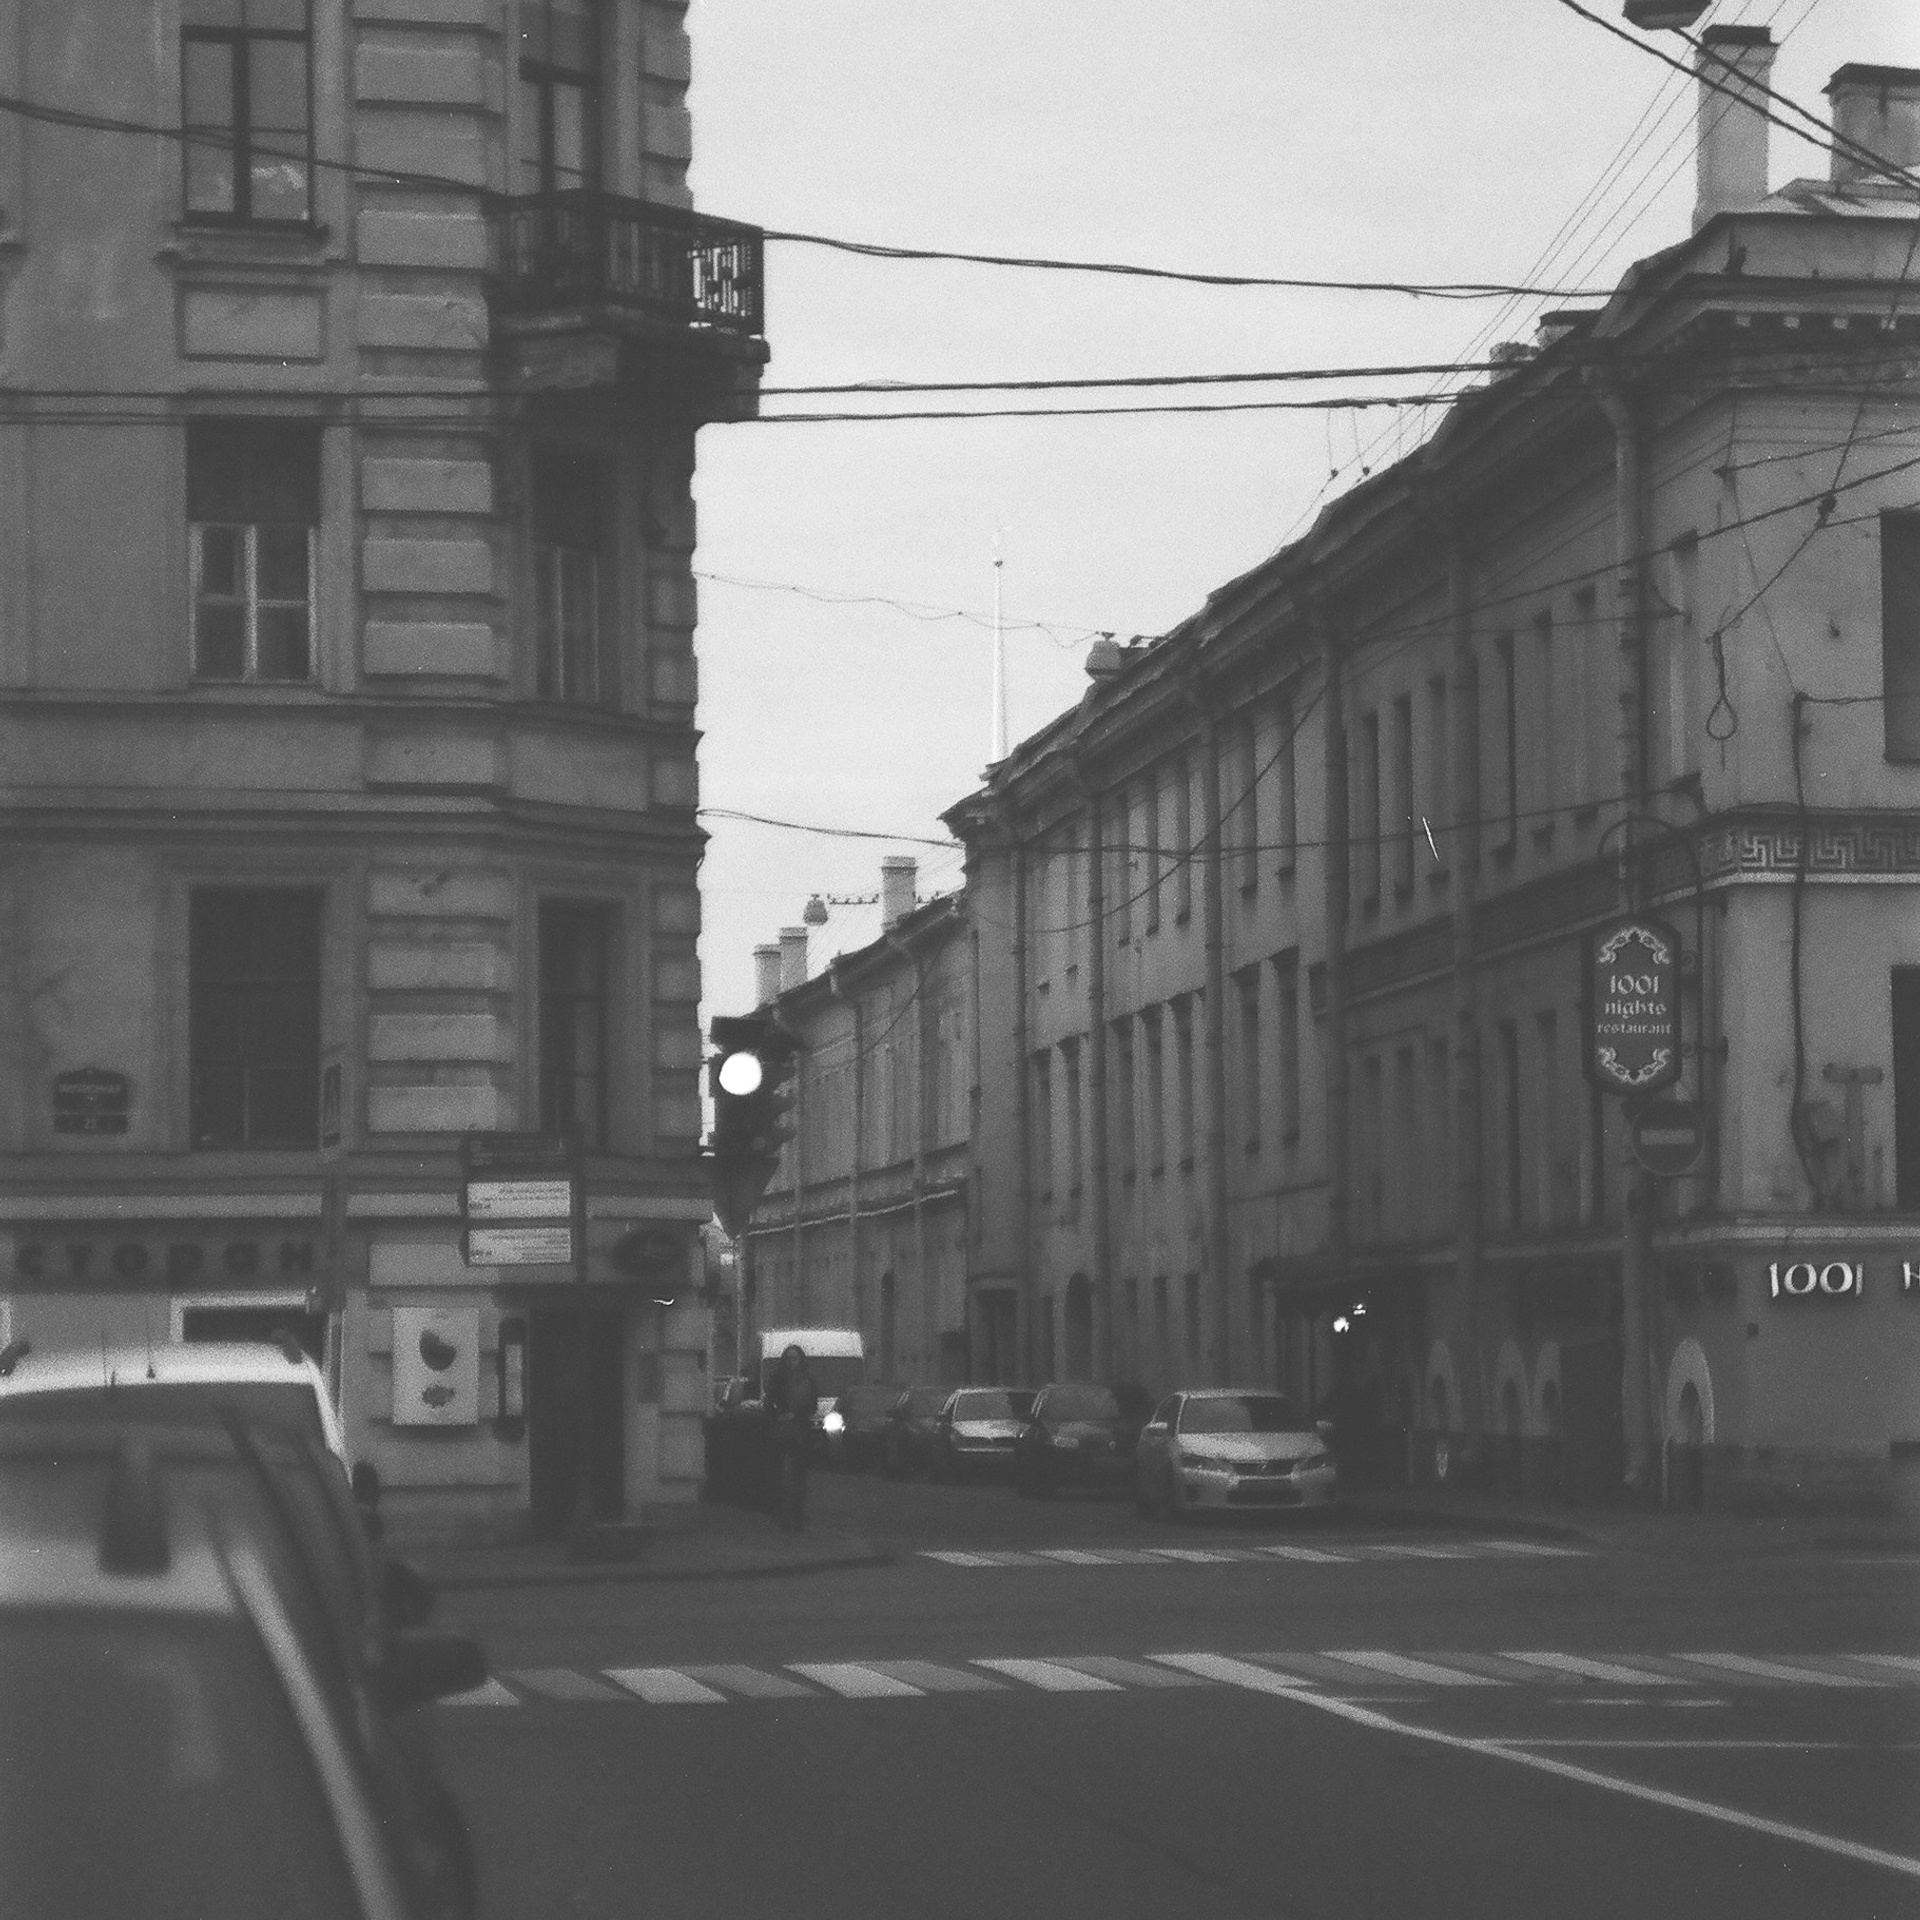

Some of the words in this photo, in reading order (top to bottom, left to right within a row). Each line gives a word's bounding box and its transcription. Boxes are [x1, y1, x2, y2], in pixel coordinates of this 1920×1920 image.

[1609, 974, 1660, 995] 1001
[1604, 999, 1667, 1019] nights
[1597, 1022, 1672, 1035] restaurant
[1768, 1262, 1864, 1298] 1001
